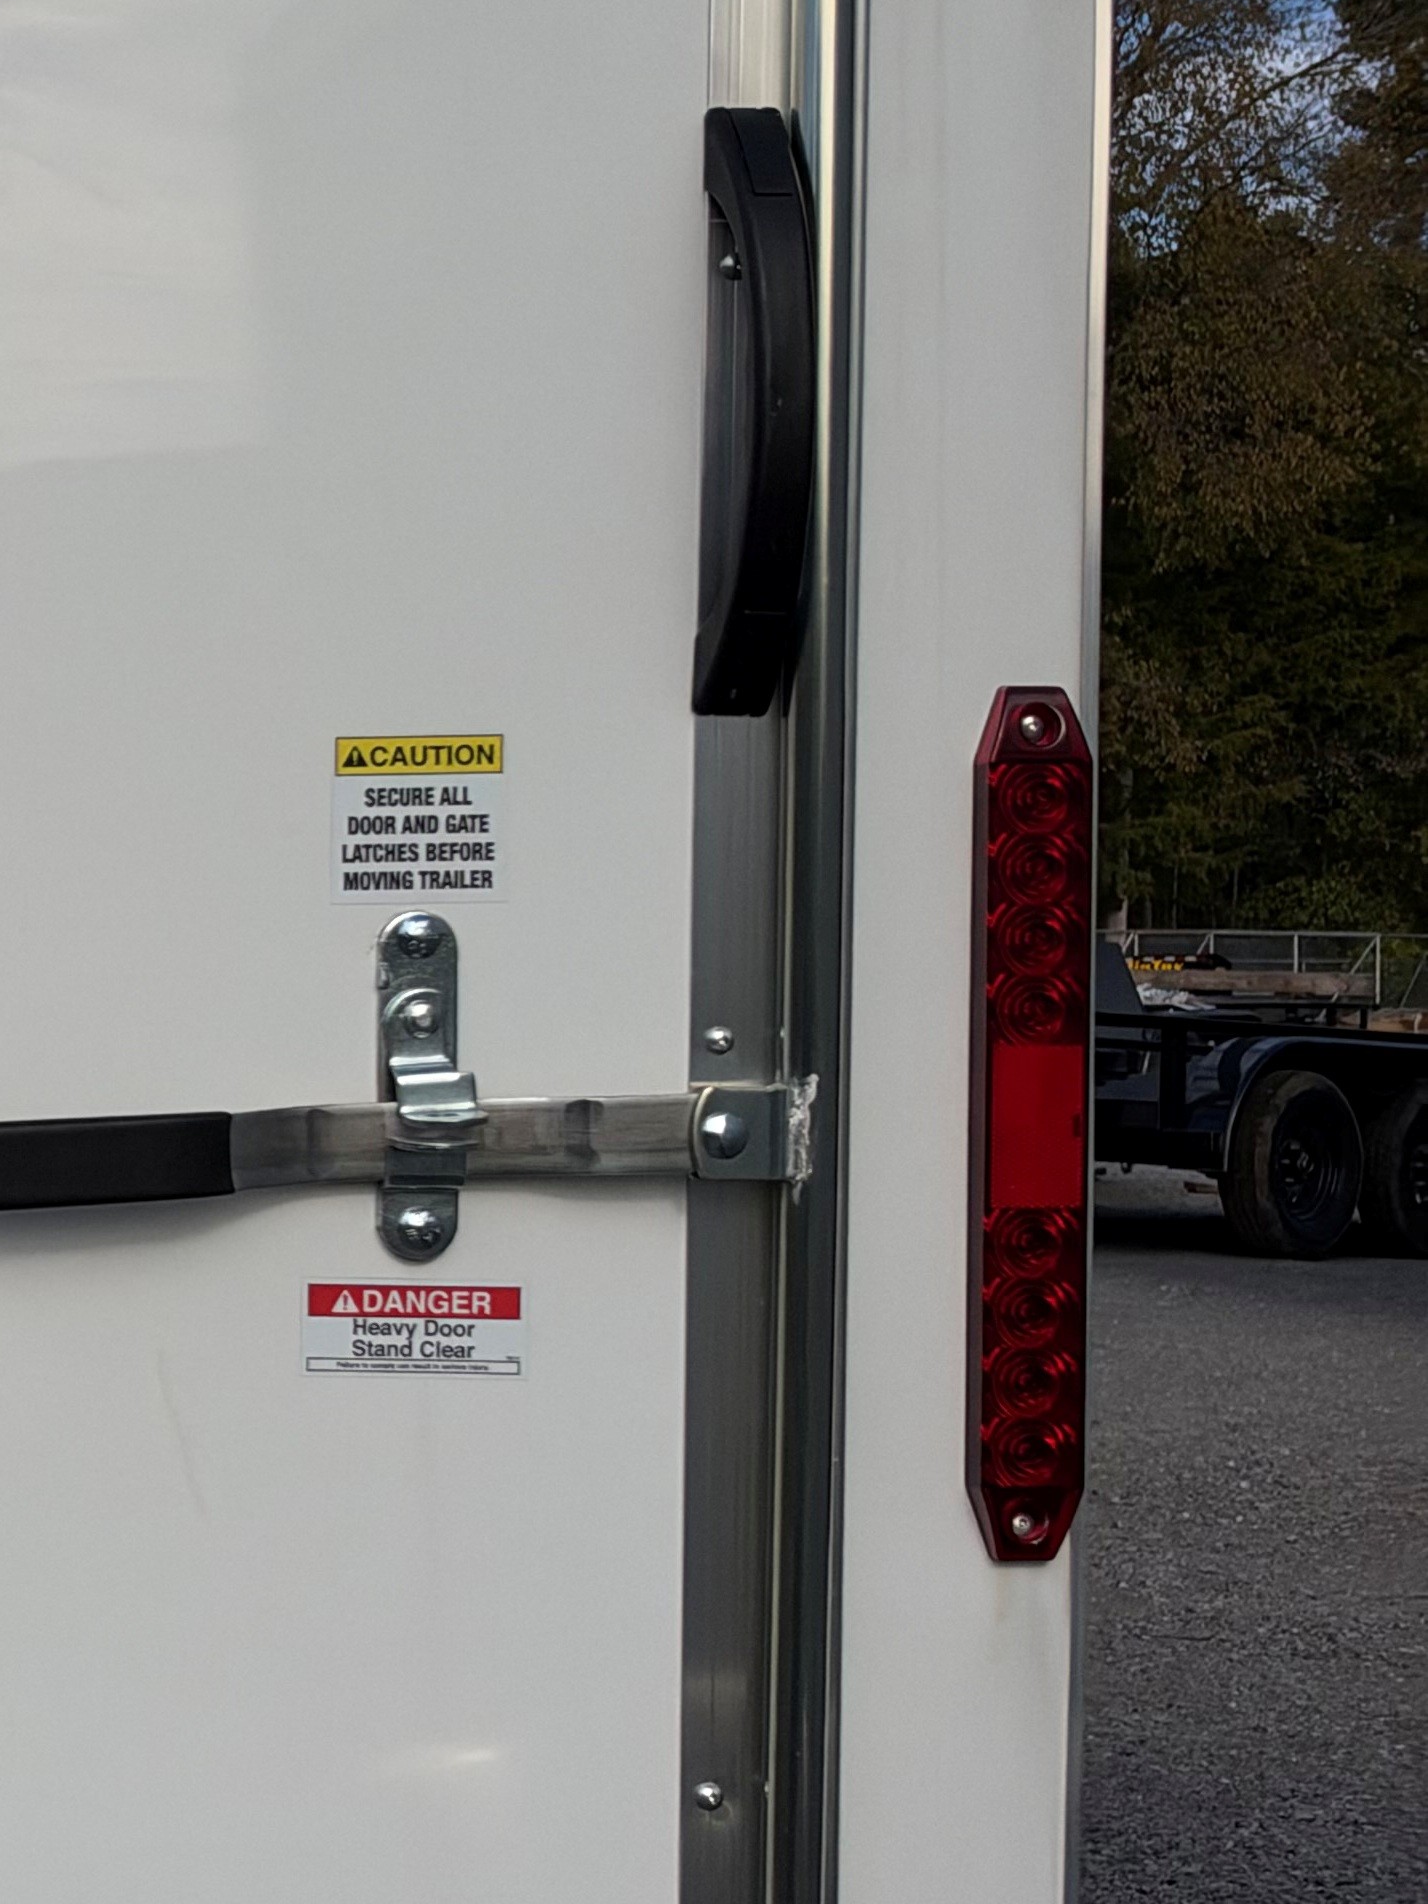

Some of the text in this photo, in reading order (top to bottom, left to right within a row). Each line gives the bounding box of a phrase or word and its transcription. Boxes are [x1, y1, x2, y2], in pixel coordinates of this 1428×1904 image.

[370, 744, 495, 767] CAUTION
[364, 786, 472, 807] SECURE ALL
[347, 814, 490, 835] DOOR AND GATE
[341, 842, 495, 863] LATCHES BEFORE
[343, 870, 493, 891] MOVING TRAILER
[362, 1290, 491, 1314] DANGER
[352, 1318, 475, 1340] Heavy Door
[352, 1339, 475, 1358] Stand Clear
